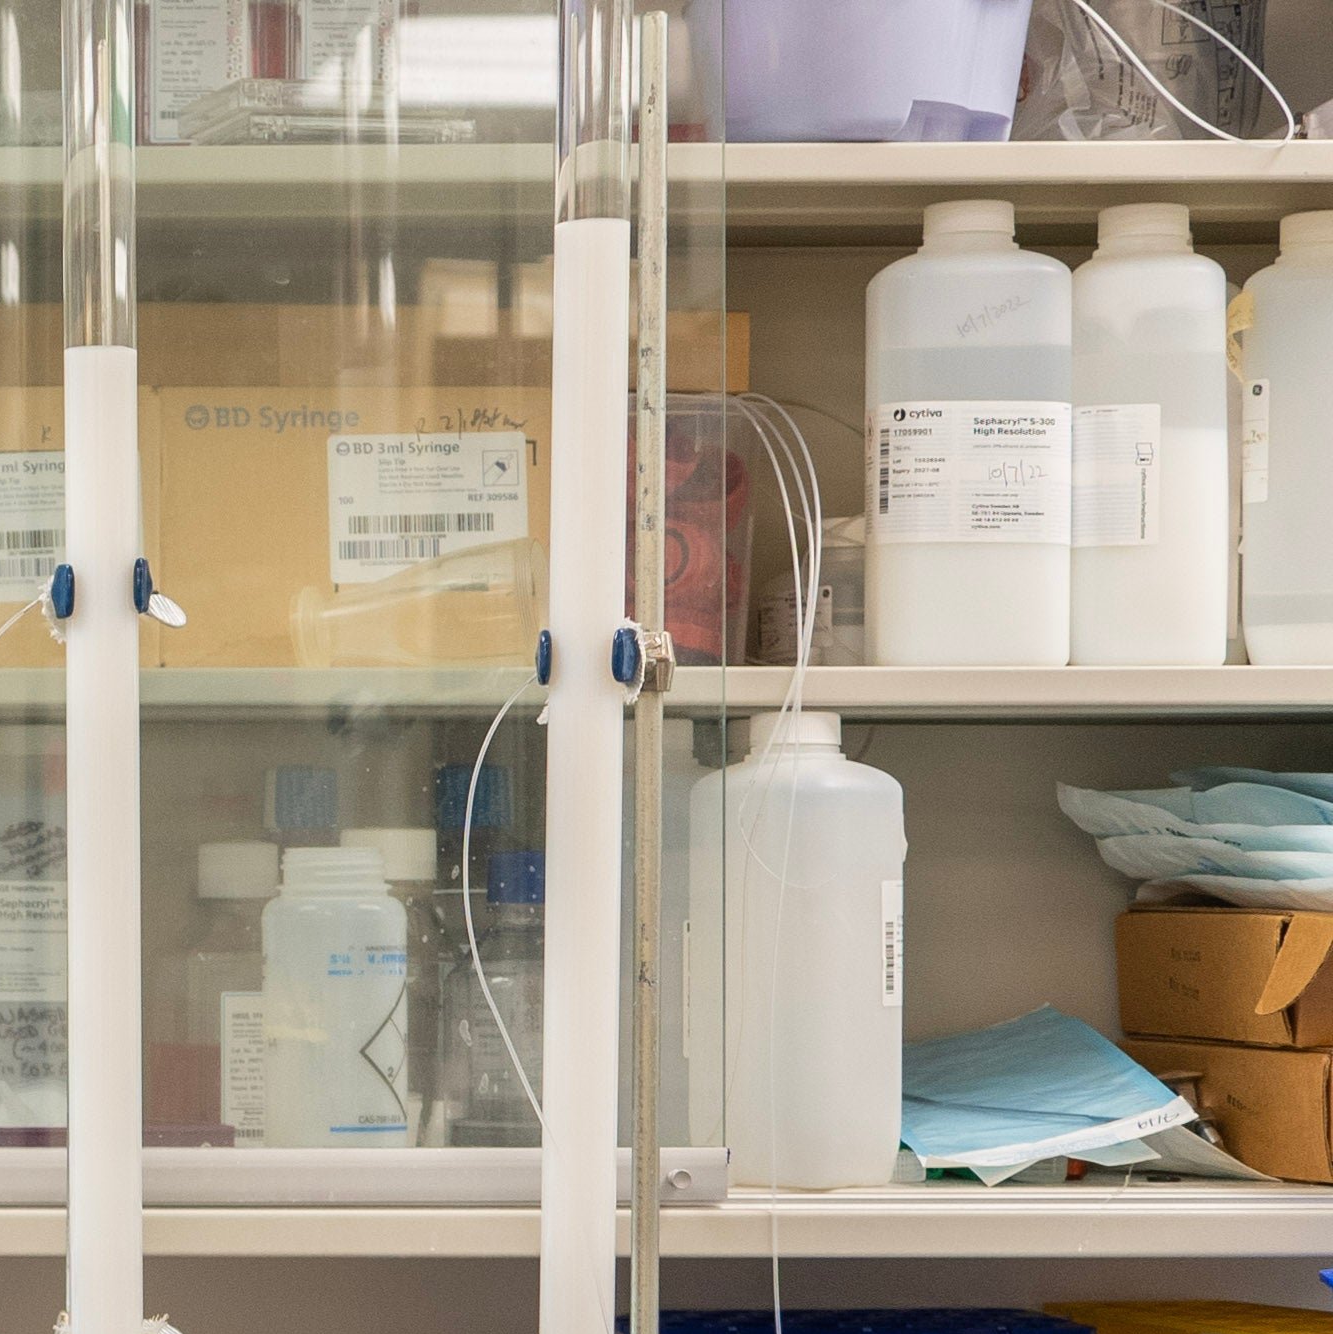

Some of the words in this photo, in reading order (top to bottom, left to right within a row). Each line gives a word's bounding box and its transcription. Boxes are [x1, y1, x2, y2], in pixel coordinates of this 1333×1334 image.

[214, 406, 251, 428] BD
[259, 404, 360, 433] Syringe
[909, 408, 943, 419] cytiva
[1030, 417, 1056, 426] S-300
[973, 427, 996, 437] High
[997, 427, 1047, 436] Resolution
[353, 443, 373, 455] BD
[379, 442, 404, 454] 3ml
[408, 441, 460, 457] Syringe
[23, 460, 66, 476] Syring
[988, 459, 1049, 488] 10/7/22
[338, 497, 354, 505] 100
[25, 909, 67, 920] Resoluti
